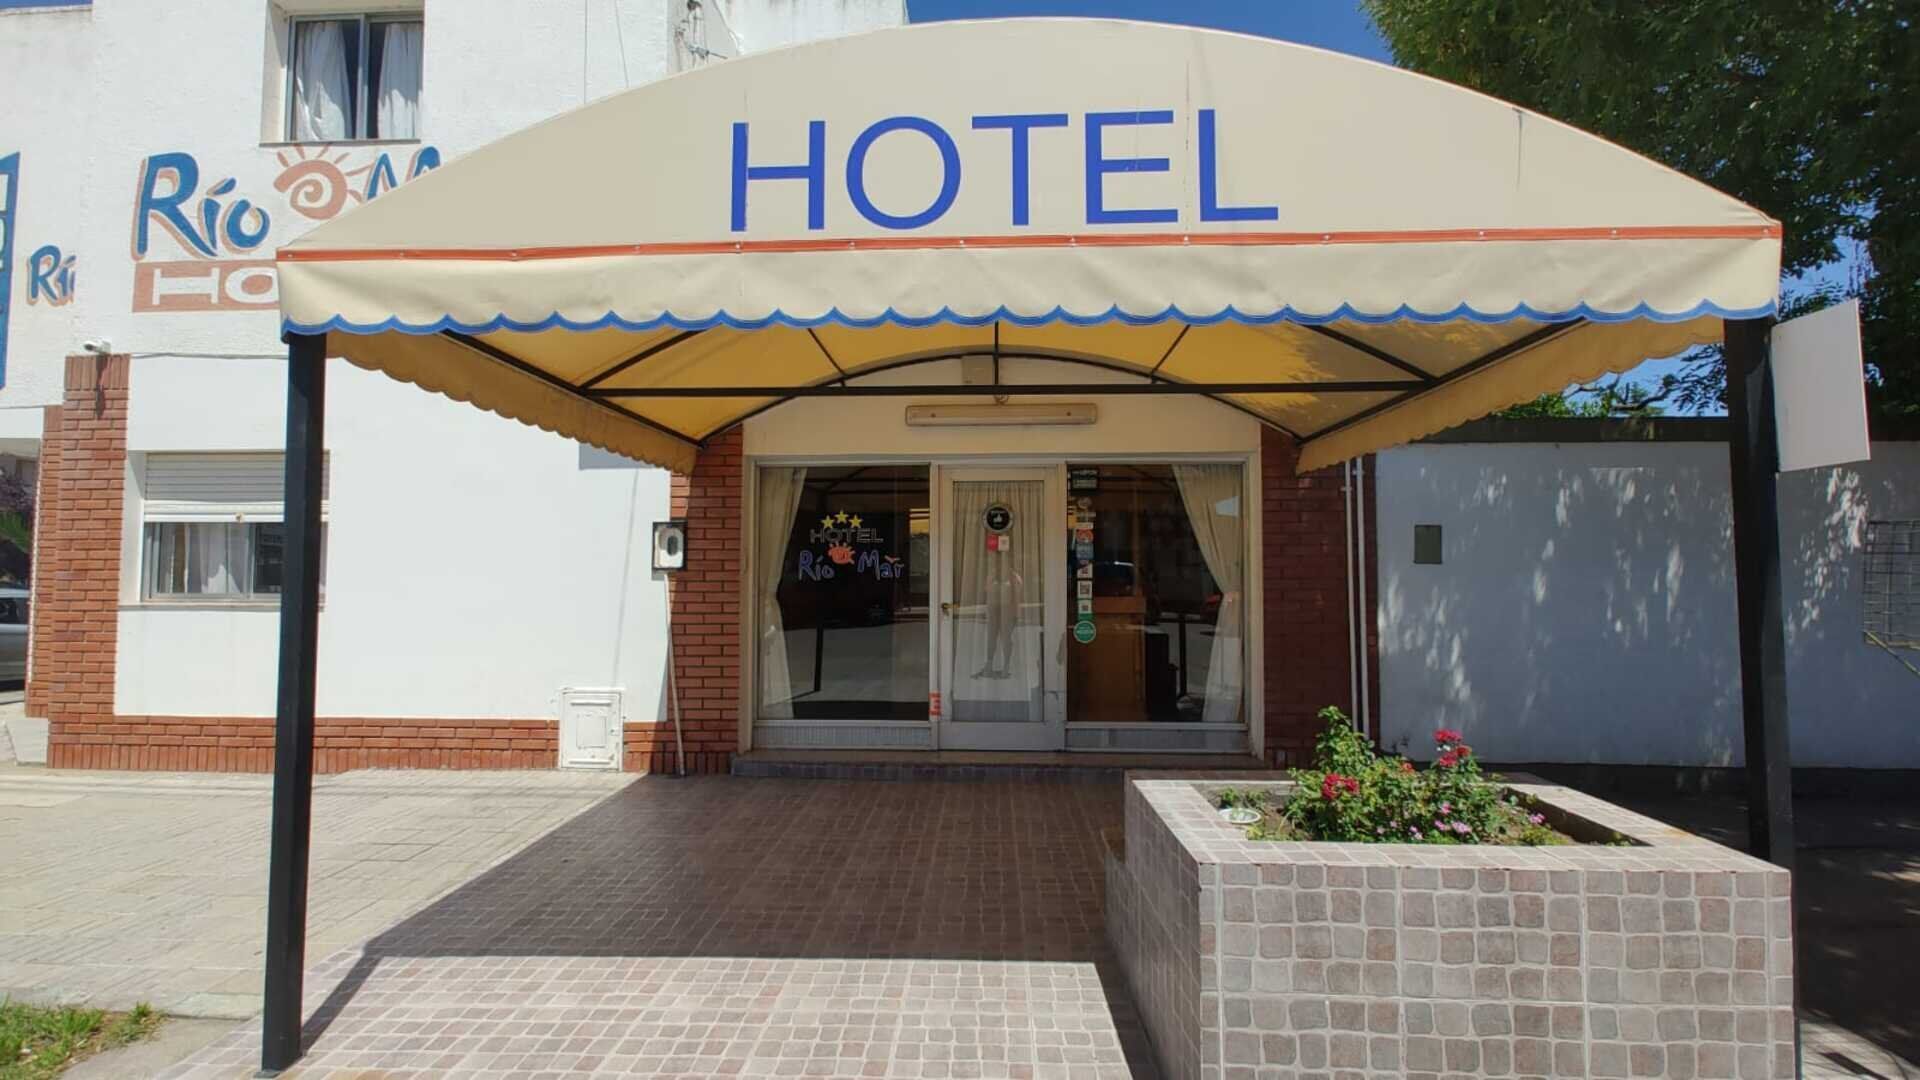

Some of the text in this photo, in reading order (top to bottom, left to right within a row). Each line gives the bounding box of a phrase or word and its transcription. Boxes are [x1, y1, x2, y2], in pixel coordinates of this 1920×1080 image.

[132, 151, 271, 260] Río
[731, 109, 1279, 232] HOTEL
[26, 244, 76, 306] Rí
[810, 527, 884, 543] HOTEL
